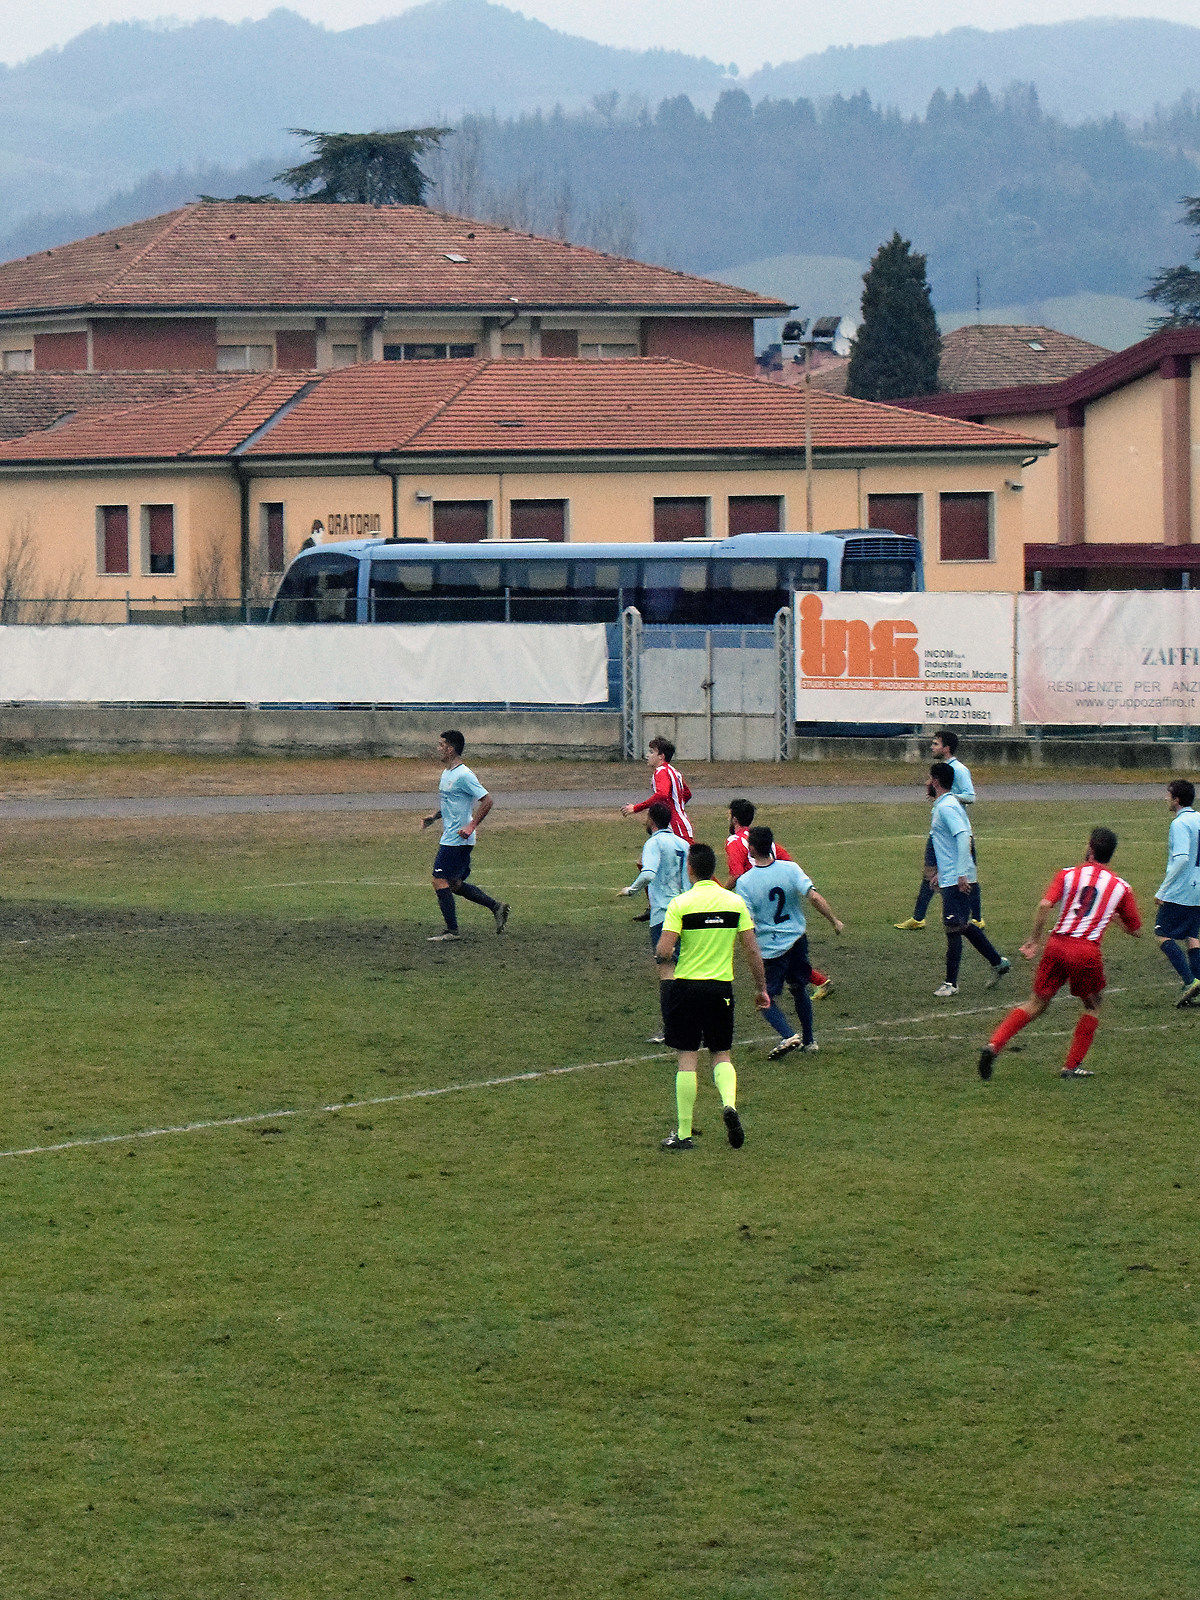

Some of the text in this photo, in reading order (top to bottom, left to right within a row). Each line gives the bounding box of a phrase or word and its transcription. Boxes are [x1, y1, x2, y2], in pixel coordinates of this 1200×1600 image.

[328, 513, 381, 534] ORATORIO
[924, 650, 954, 659] INCOM
[972, 671, 1008, 679] Moderne
[1048, 681, 1123, 693] RESIDENZE
[1134, 681, 1161, 693] PER
[924, 697, 972, 706] URBANIA
[938, 710, 960, 719] 0722
[768, 886, 790, 924] 2
[1073, 885, 1098, 918] 9
